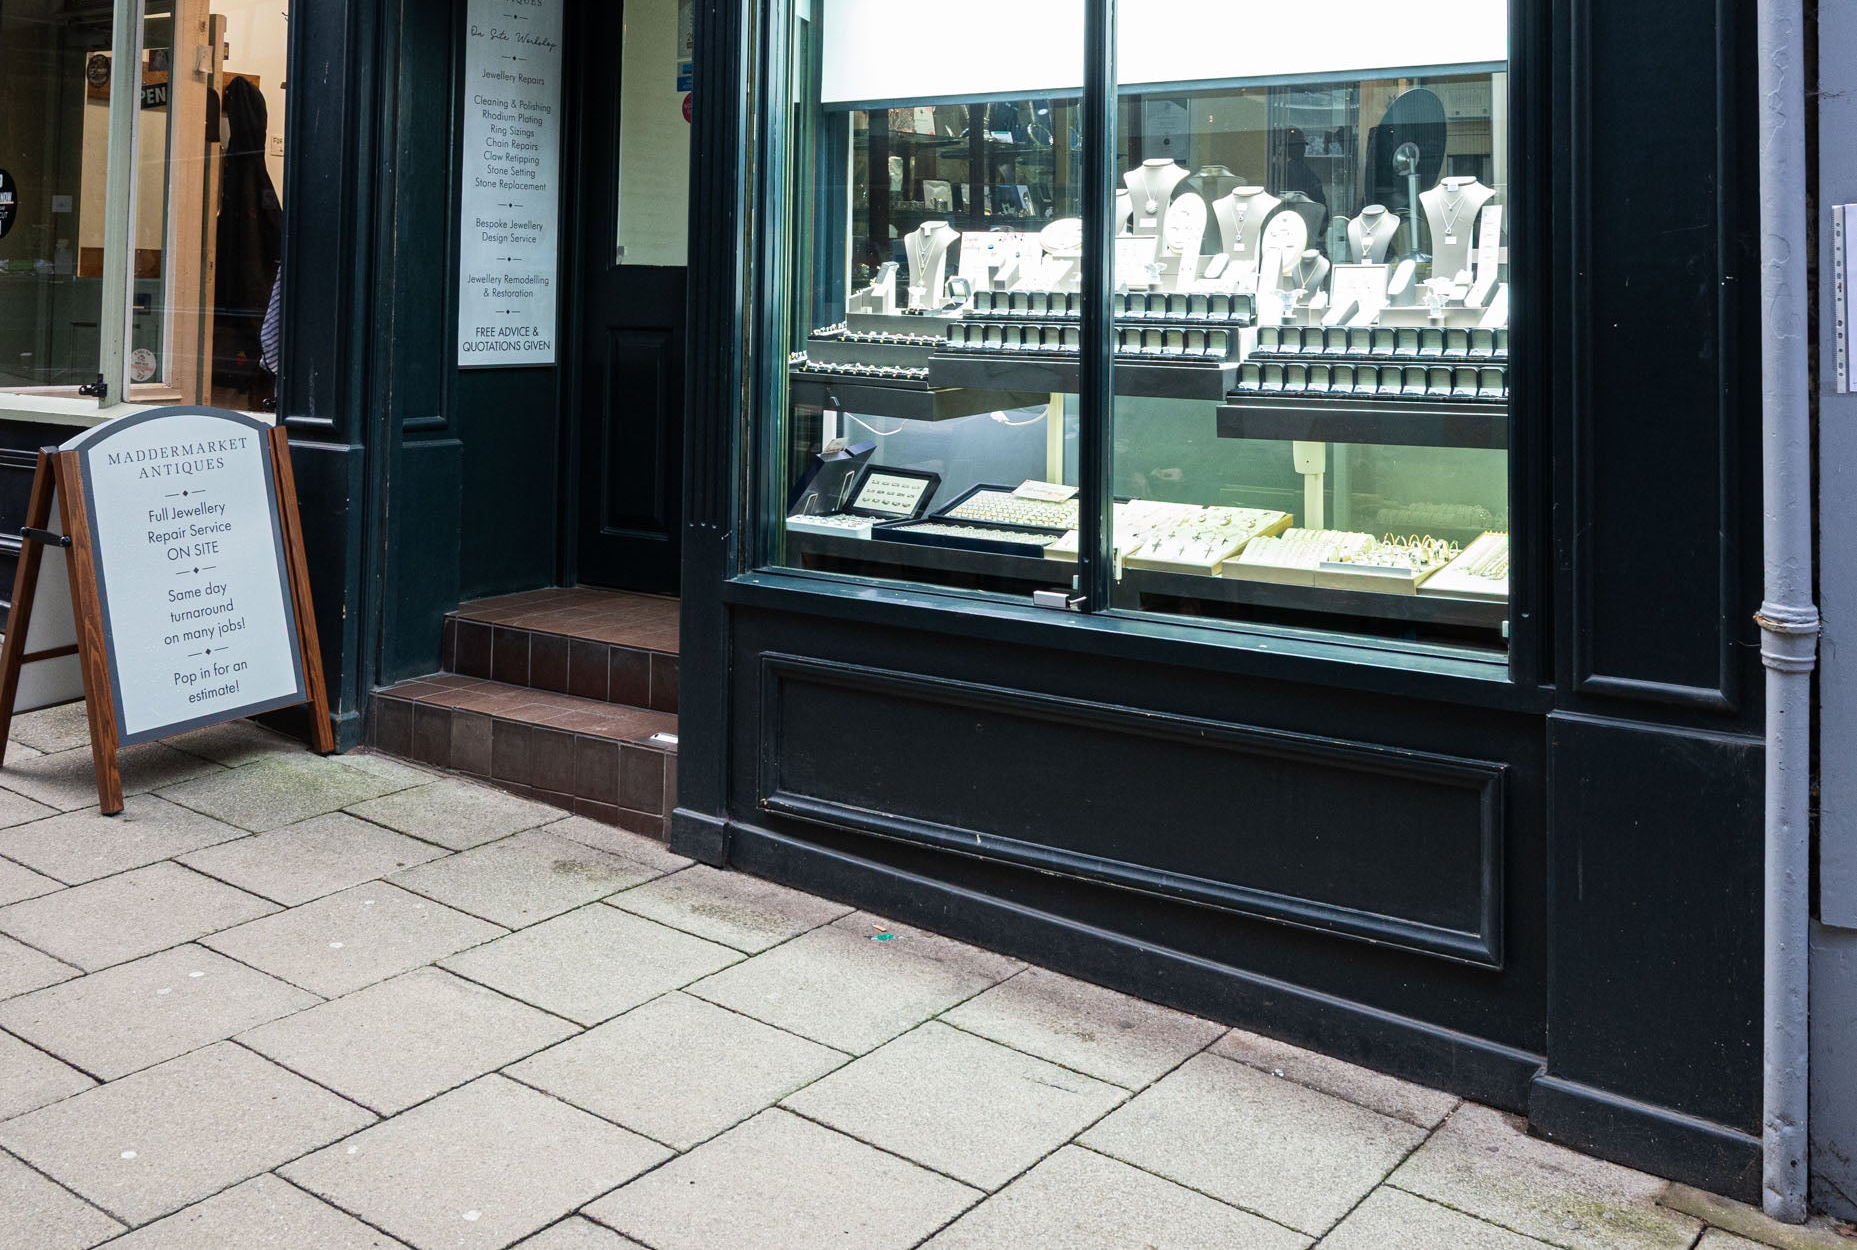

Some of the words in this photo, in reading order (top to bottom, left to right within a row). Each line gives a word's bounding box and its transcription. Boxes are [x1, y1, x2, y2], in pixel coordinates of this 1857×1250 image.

[481, 70, 516, 83] Jewellery
[518, 73, 545, 86] Repairs
[141, 87, 166, 104] PEN
[474, 95, 509, 110] Cleaning
[511, 100, 517, 109] &
[519, 101, 552, 115] Polishing
[482, 110, 516, 123] Rhodium
[518, 113, 543, 126] Plating
[490, 125, 507, 137] Ring
[510, 127, 535, 138] Sizings
[486, 137, 509, 149] Chain
[511, 139, 538, 152] Repairs
[483, 151, 503, 162] Claw
[506, 153, 540, 166] Retipping
[487, 164, 508, 176] Stone
[510, 166, 536, 179] Setting
[475, 177, 497, 188] Stone
[499, 179, 546, 192] Replacement
[476, 218, 507, 230] Bespoke
[509, 220, 543, 232] Jewellery
[482, 232, 508, 244] Design
[510, 233, 537, 243] Service
[467, 274, 502, 287] Jewellery
[504, 274, 549, 287] Remodelling
[483, 290, 489, 298] &
[492, 288, 534, 298] Restoration
[476, 327, 495, 337] FREE
[498, 326, 530, 337] ADVICE
[532, 327, 539, 337] &
[462, 341, 521, 352] QUOTATIONS
[523, 341, 550, 351] GIVEN
[108, 437, 248, 466] MADDERMARKET
[139, 457, 225, 479] ANTIQUES
[148, 508, 169, 523] Full
[171, 501, 226, 520] Jewellery
[147, 527, 187, 545] Repair
[190, 520, 232, 537] Service
[167, 547, 191, 562] ON
[194, 541, 219, 556] SITE
[168, 587, 202, 602] Same
[205, 582, 227, 598] day
[170, 599, 234, 623] turnaround
[164, 633, 179, 646] on
[183, 626, 215, 643] many
[218, 618, 246, 638] jobs!
[174, 671, 197, 687] Pop
[200, 666, 211, 678] in
[213, 662, 230, 676] for
[233, 659, 248, 672] an
[188, 680, 240, 704] estimate!
